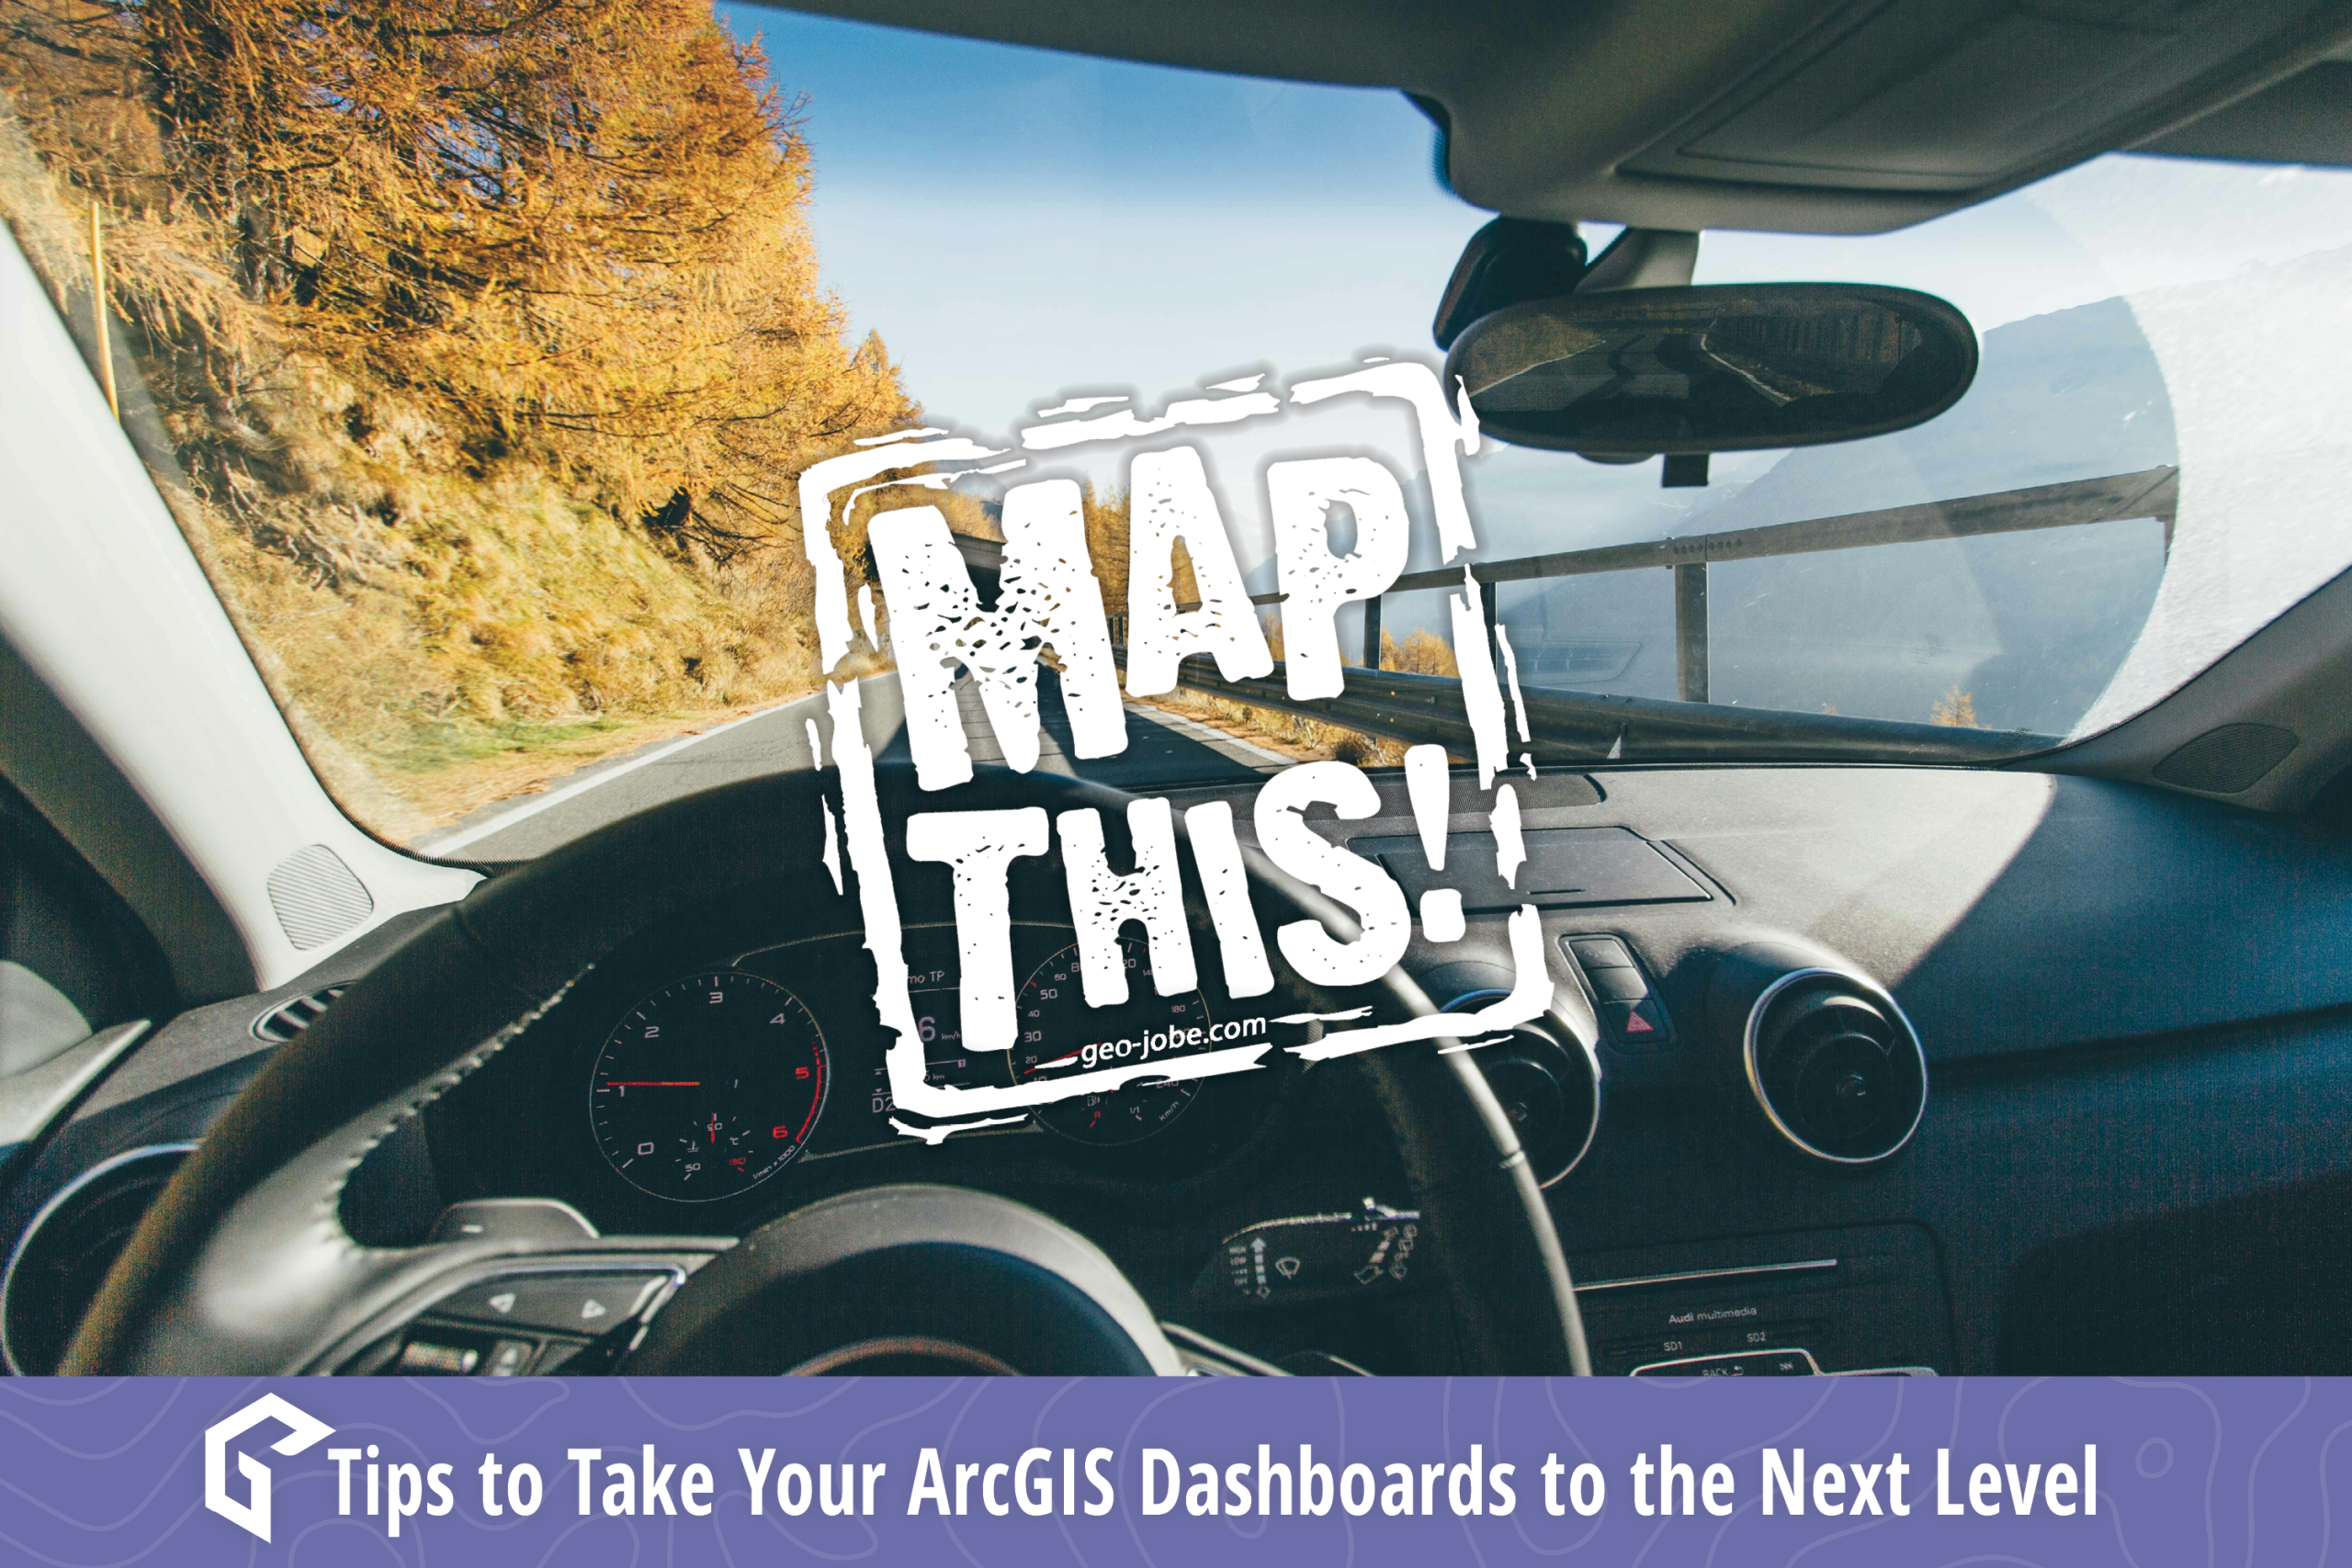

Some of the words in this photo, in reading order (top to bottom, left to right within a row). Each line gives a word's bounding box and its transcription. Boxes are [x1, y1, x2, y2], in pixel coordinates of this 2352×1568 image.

[929, 970, 945, 982] TP
[709, 991, 723, 1004] 3
[1040, 988, 1057, 1000] 50
[769, 1013, 786, 1025] 4
[1027, 1010, 1040, 1018] 40
[644, 1026, 660, 1039] 2
[941, 1031, 961, 1042] km/h
[1023, 1031, 1042, 1043] 30
[1024, 1055, 1038, 1065] 20
[795, 1066, 809, 1079] 5
[618, 1085, 626, 1098] 1
[772, 1125, 788, 1138] 6
[638, 1142, 654, 1156] 0
[684, 1162, 701, 1172] 50
[1668, 1312, 1694, 1324] Audi
[1697, 1307, 1758, 1321] multimedia
[1747, 1332, 1766, 1343] SD2
[1663, 1341, 1682, 1352] SD1
